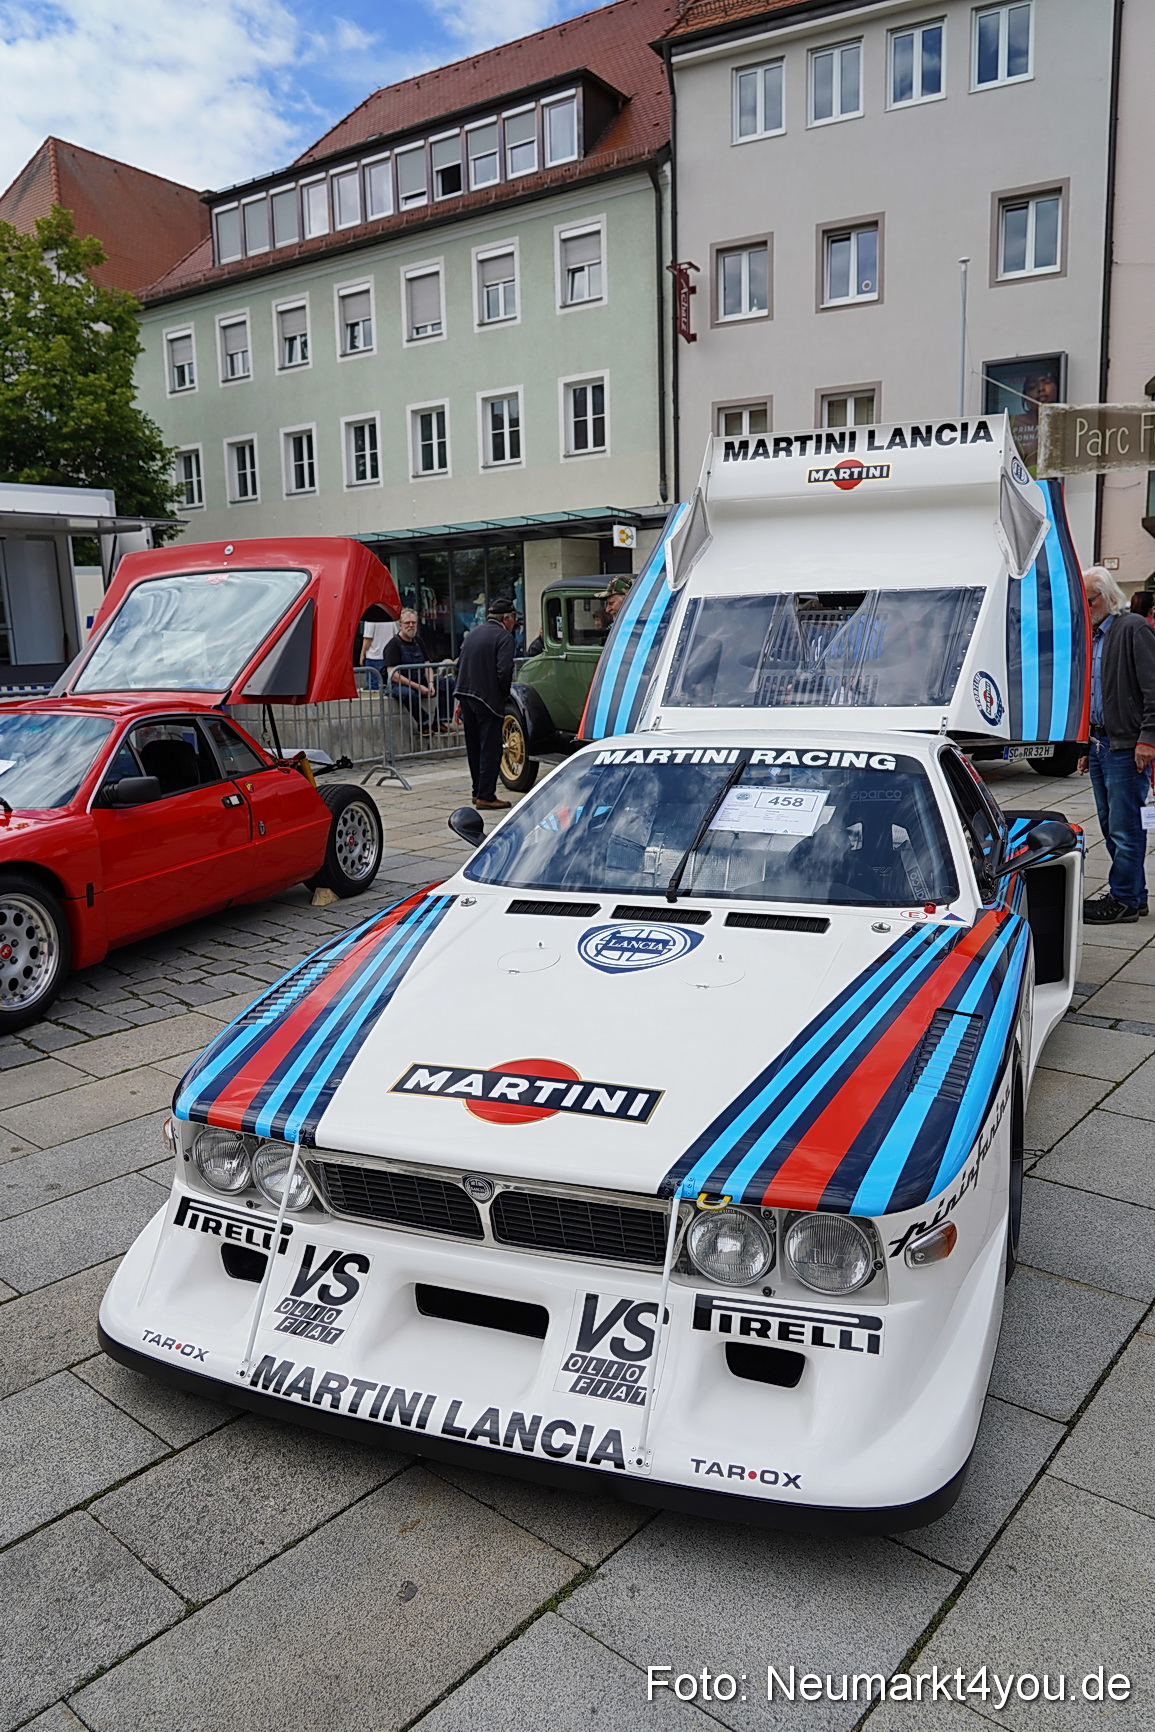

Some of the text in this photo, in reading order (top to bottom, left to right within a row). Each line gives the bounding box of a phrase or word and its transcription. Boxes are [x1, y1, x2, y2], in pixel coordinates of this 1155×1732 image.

[722, 420, 994, 463] MARTINI LANCIA
[1075, 411, 1155, 458] Parc F
[810, 465, 890, 482] MARTINI
[592, 749, 898, 771] MARTINI RACING
[1008, 748, 1019, 758] SC
[1023, 747, 1033, 757] RR
[768, 796, 804, 807] 458
[850, 789, 902, 802] sparco
[606, 939, 664, 951] LANCIA
[402, 1068, 650, 1117] MARTINI
[173, 1195, 294, 1256] PIRELLI
[289, 1243, 371, 1307] VS
[277, 1299, 340, 1325] OLIO
[692, 1293, 883, 1355] PIRELLI
[278, 1317, 342, 1343] FIAT
[575, 1292, 670, 1362] VS
[566, 1355, 642, 1382] OLIO
[573, 1377, 650, 1404] FIAT
[250, 1354, 627, 1471] MARTINI LANCIA
